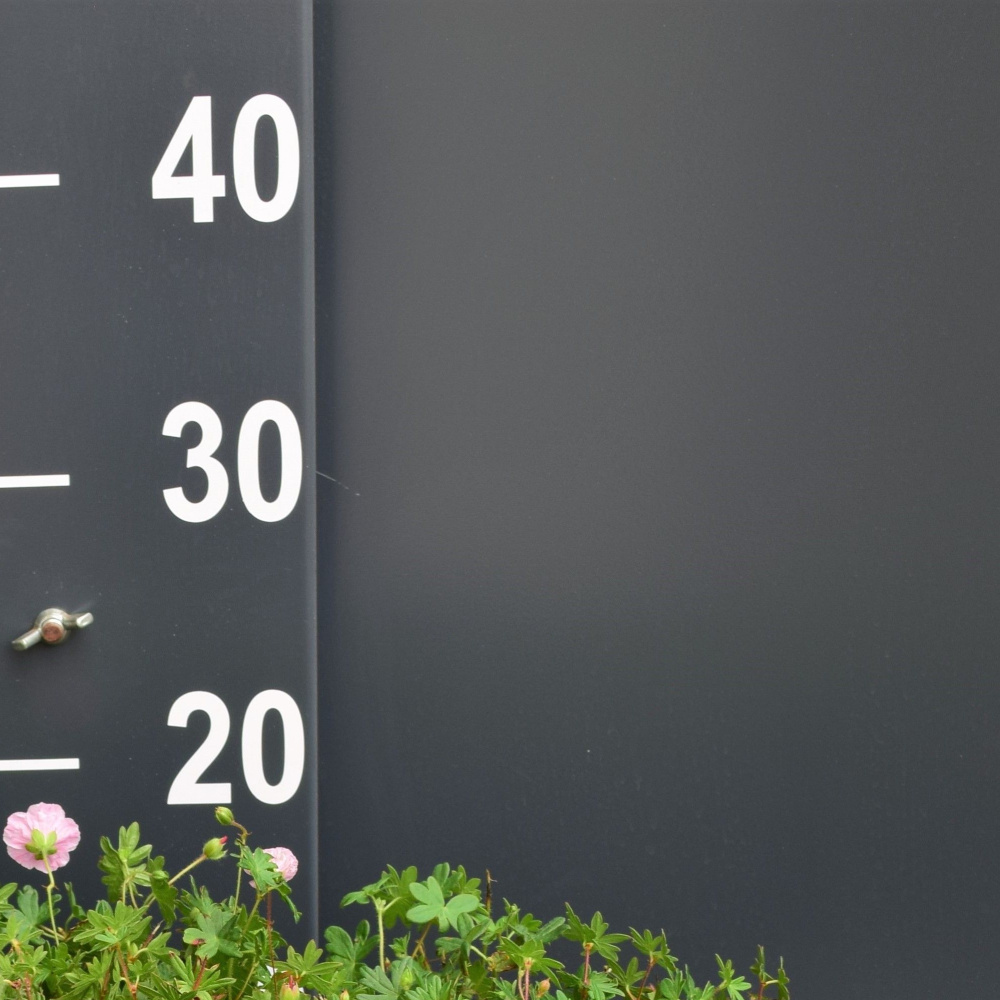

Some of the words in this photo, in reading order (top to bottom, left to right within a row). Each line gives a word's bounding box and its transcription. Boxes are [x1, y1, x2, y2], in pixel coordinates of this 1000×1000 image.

[151, 93, 300, 224] 40
[162, 399, 304, 524] 30
[166, 689, 305, 805] 20
